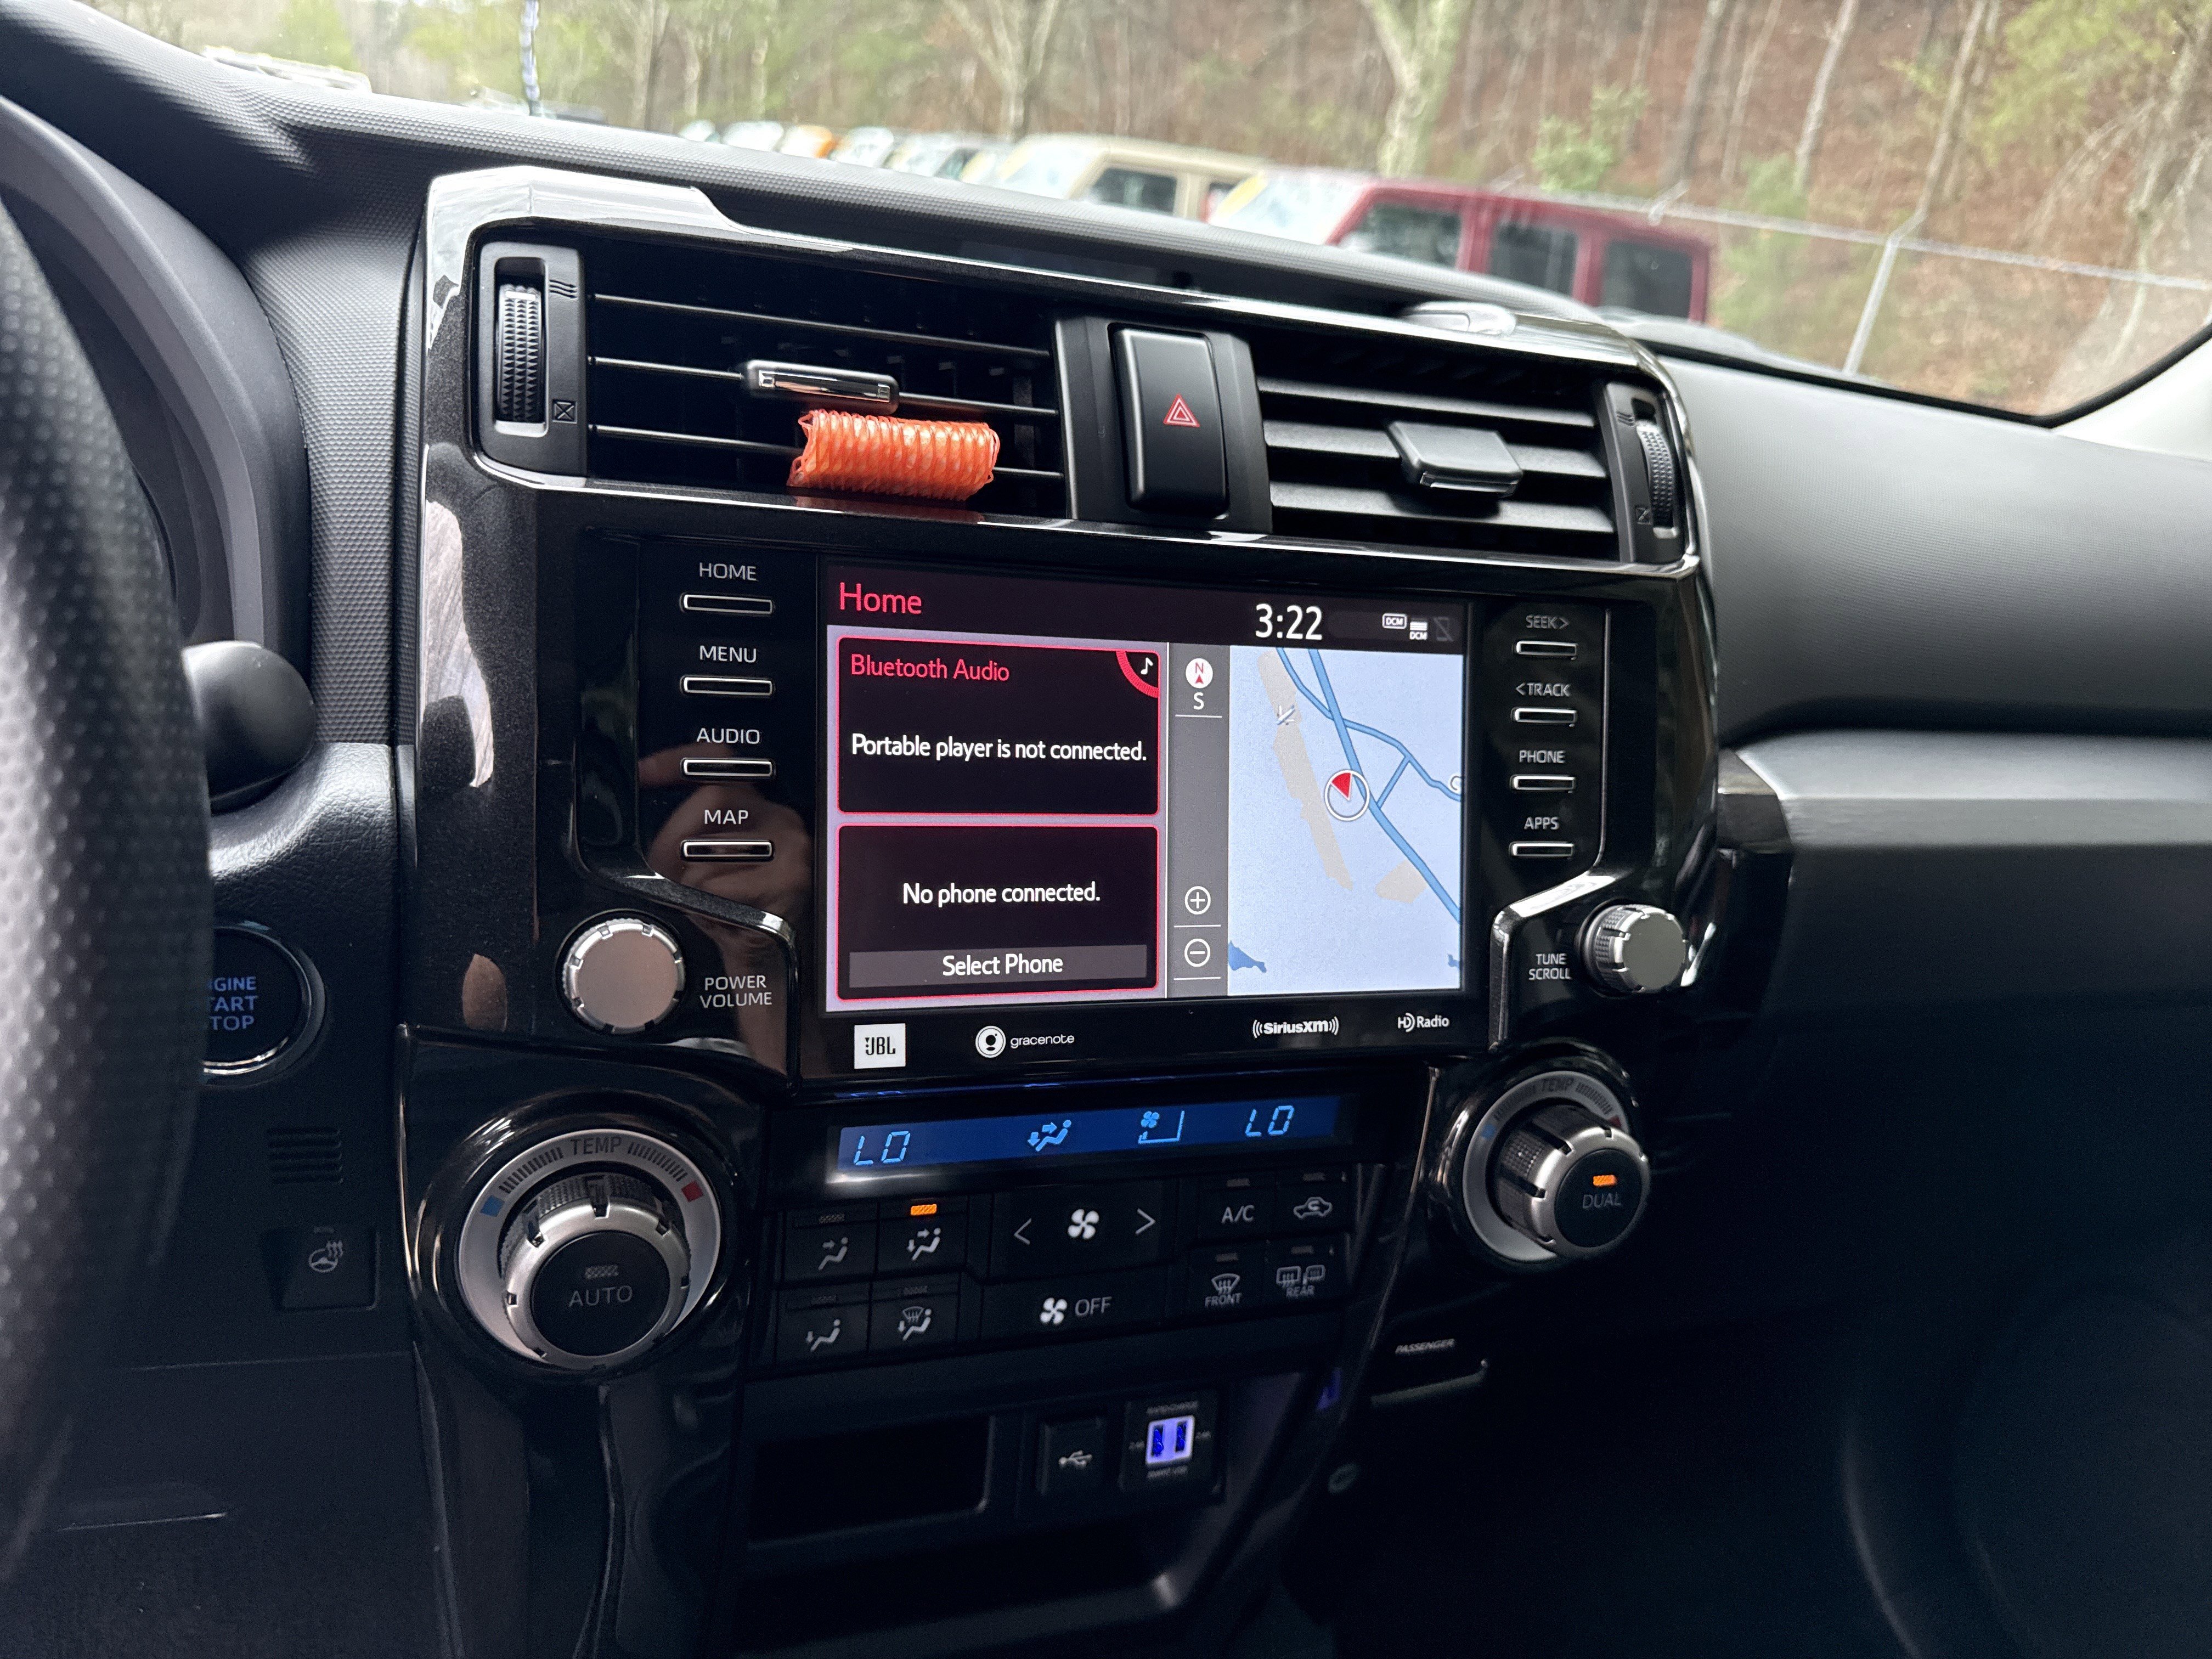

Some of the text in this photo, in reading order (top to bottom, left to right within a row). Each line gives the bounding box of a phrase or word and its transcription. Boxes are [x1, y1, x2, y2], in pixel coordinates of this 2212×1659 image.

[699, 562, 757, 581] HOME
[839, 582, 922, 614] Home
[1255, 603, 1323, 640] 3:22
[1386, 617, 1404, 627] DCM
[1409, 630, 1427, 640] DCM
[699, 645, 757, 663] MENU
[851, 653, 1009, 681] Bluetooth Audio
[1195, 662, 1204, 674] N
[1193, 692, 1204, 710] S
[696, 727, 760, 744] AUDIO
[852, 733, 1147, 761] Portable player is not connected.
[1519, 749, 1565, 764] PHONE
[704, 809, 749, 825] MAP
[1524, 816, 1559, 830] APPS
[903, 881, 1101, 908] No phone connected.
[943, 953, 1063, 976] Select Phone
[1536, 953, 1565, 965] TUNE
[1528, 967, 1571, 980] SCROLL
[208, 976, 257, 991] GINE
[704, 975, 767, 991] POWER
[210, 995, 258, 1012] ART
[699, 991, 772, 1008] VOLUME
[210, 1015, 255, 1030] TOP
[1397, 1012, 1449, 1032] HD Radio
[865, 1036, 896, 1056] JBL
[1010, 1034, 1075, 1049] gracenote
[1541, 1077, 1574, 1093] TEMP
[569, 1135, 622, 1155] TEMP
[1582, 1192, 1621, 1209] DUAL
[1221, 1205, 1254, 1223] A/C
[568, 1285, 633, 1307] AUTO
[1286, 1284, 1314, 1297] REAR
[1075, 1296, 1111, 1316] OFF
[1205, 1293, 1242, 1307] FRONT
